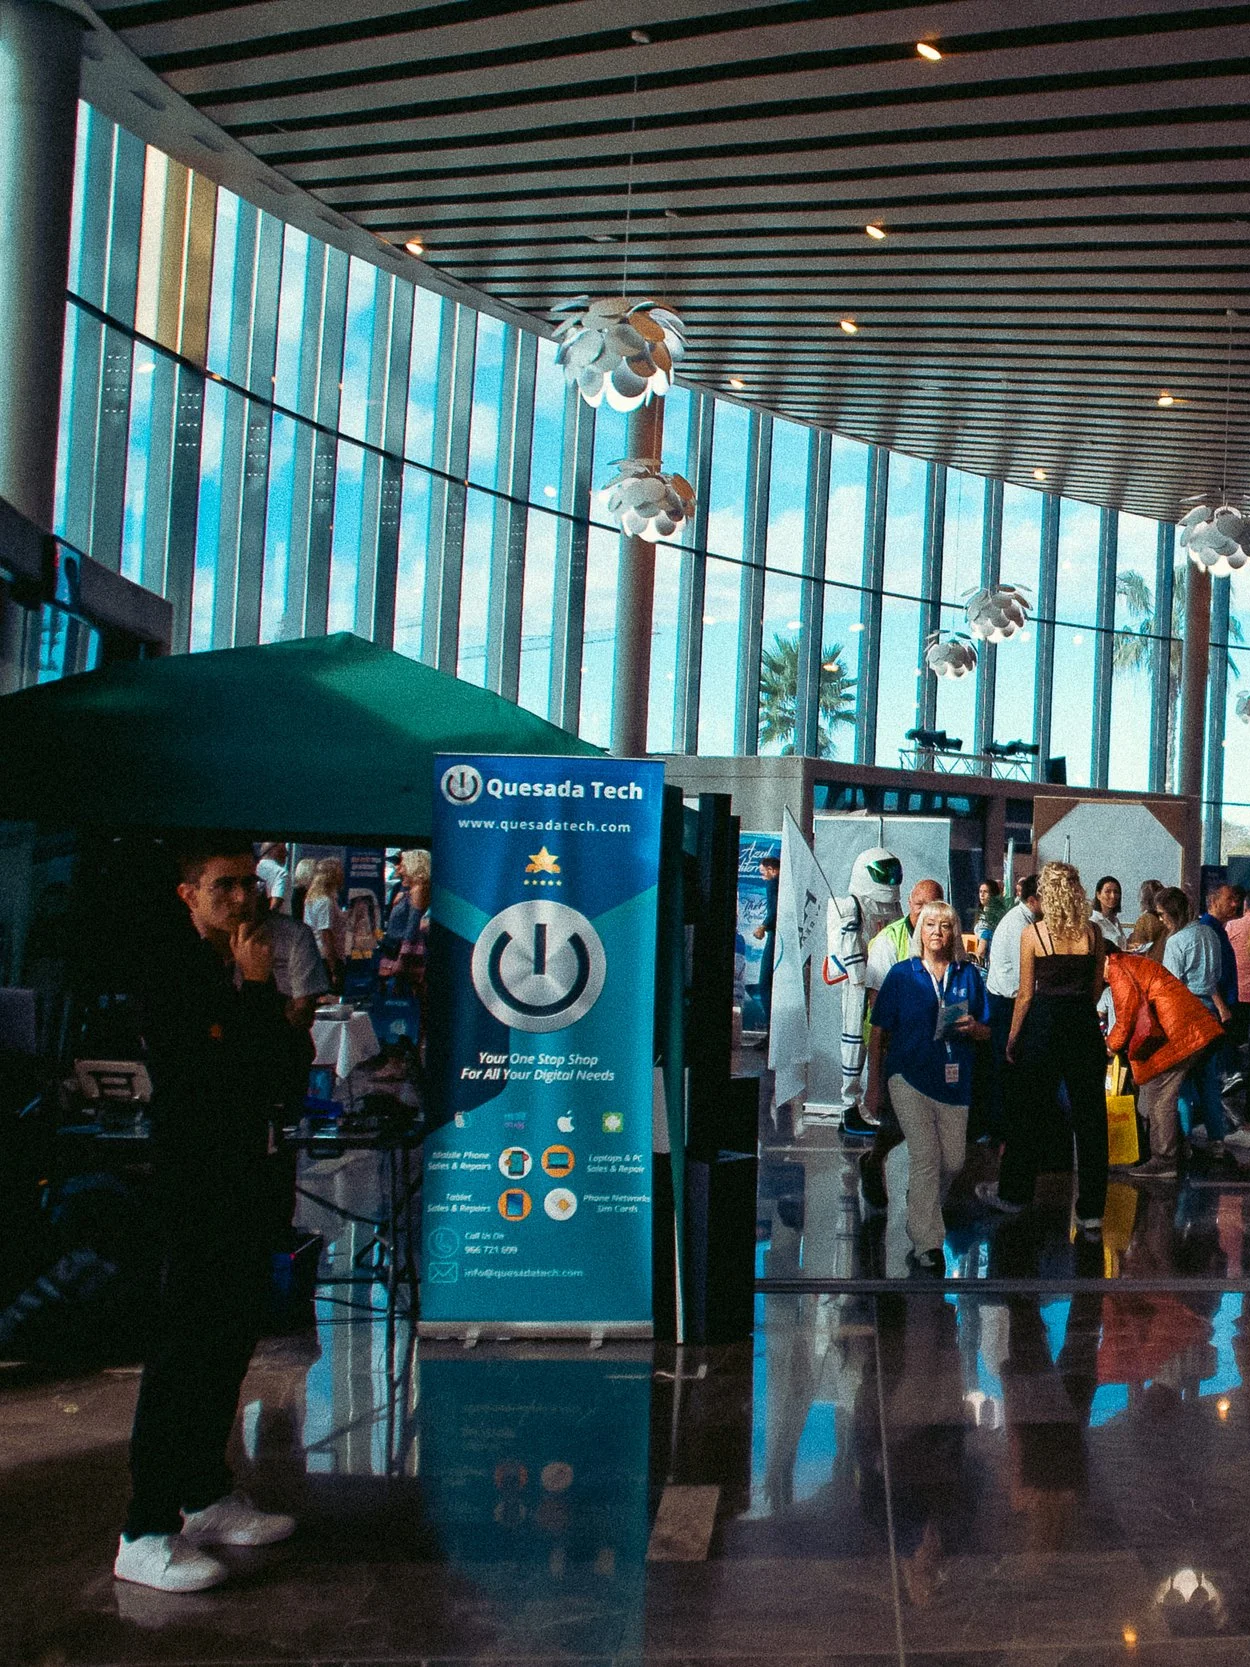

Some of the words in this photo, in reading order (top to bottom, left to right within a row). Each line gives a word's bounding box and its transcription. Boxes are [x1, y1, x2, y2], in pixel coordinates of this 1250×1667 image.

[487, 778, 585, 799] Quesada
[591, 781, 643, 800] Tech
[458, 819, 631, 833] www.quesadatech.com
[479, 1052, 508, 1064] Your
[509, 1053, 535, 1065] One
[537, 1053, 565, 1067] Stop
[568, 1053, 599, 1068] Shop
[460, 1068, 481, 1080] For
[483, 1068, 500, 1080] All
[502, 1068, 531, 1081] Your
[533, 1068, 574, 1084] Digital
[576, 1069, 615, 1082] Needs
[463, 1150, 490, 1160] Phone
[589, 1153, 622, 1164] Laptops
[624, 1154, 631, 1162] &
[632, 1154, 643, 1162] PC
[428, 1162, 449, 1170] Sales
[451, 1162, 458, 1170] &
[460, 1162, 491, 1172] Repairs
[586, 1164, 608, 1173] Sales
[609, 1164, 617, 1173] &
[446, 1193, 472, 1201] Tablet
[583, 1193, 610, 1202] Phone
[611, 1193, 651, 1203] Networks
[427, 1204, 449, 1213] Sales
[450, 1204, 457, 1213] &
[459, 1204, 491, 1214] Repairs
[614, 1205, 638, 1213] Cards
[464, 1232, 480, 1240] Call
[483, 1245, 499, 1255] 721
